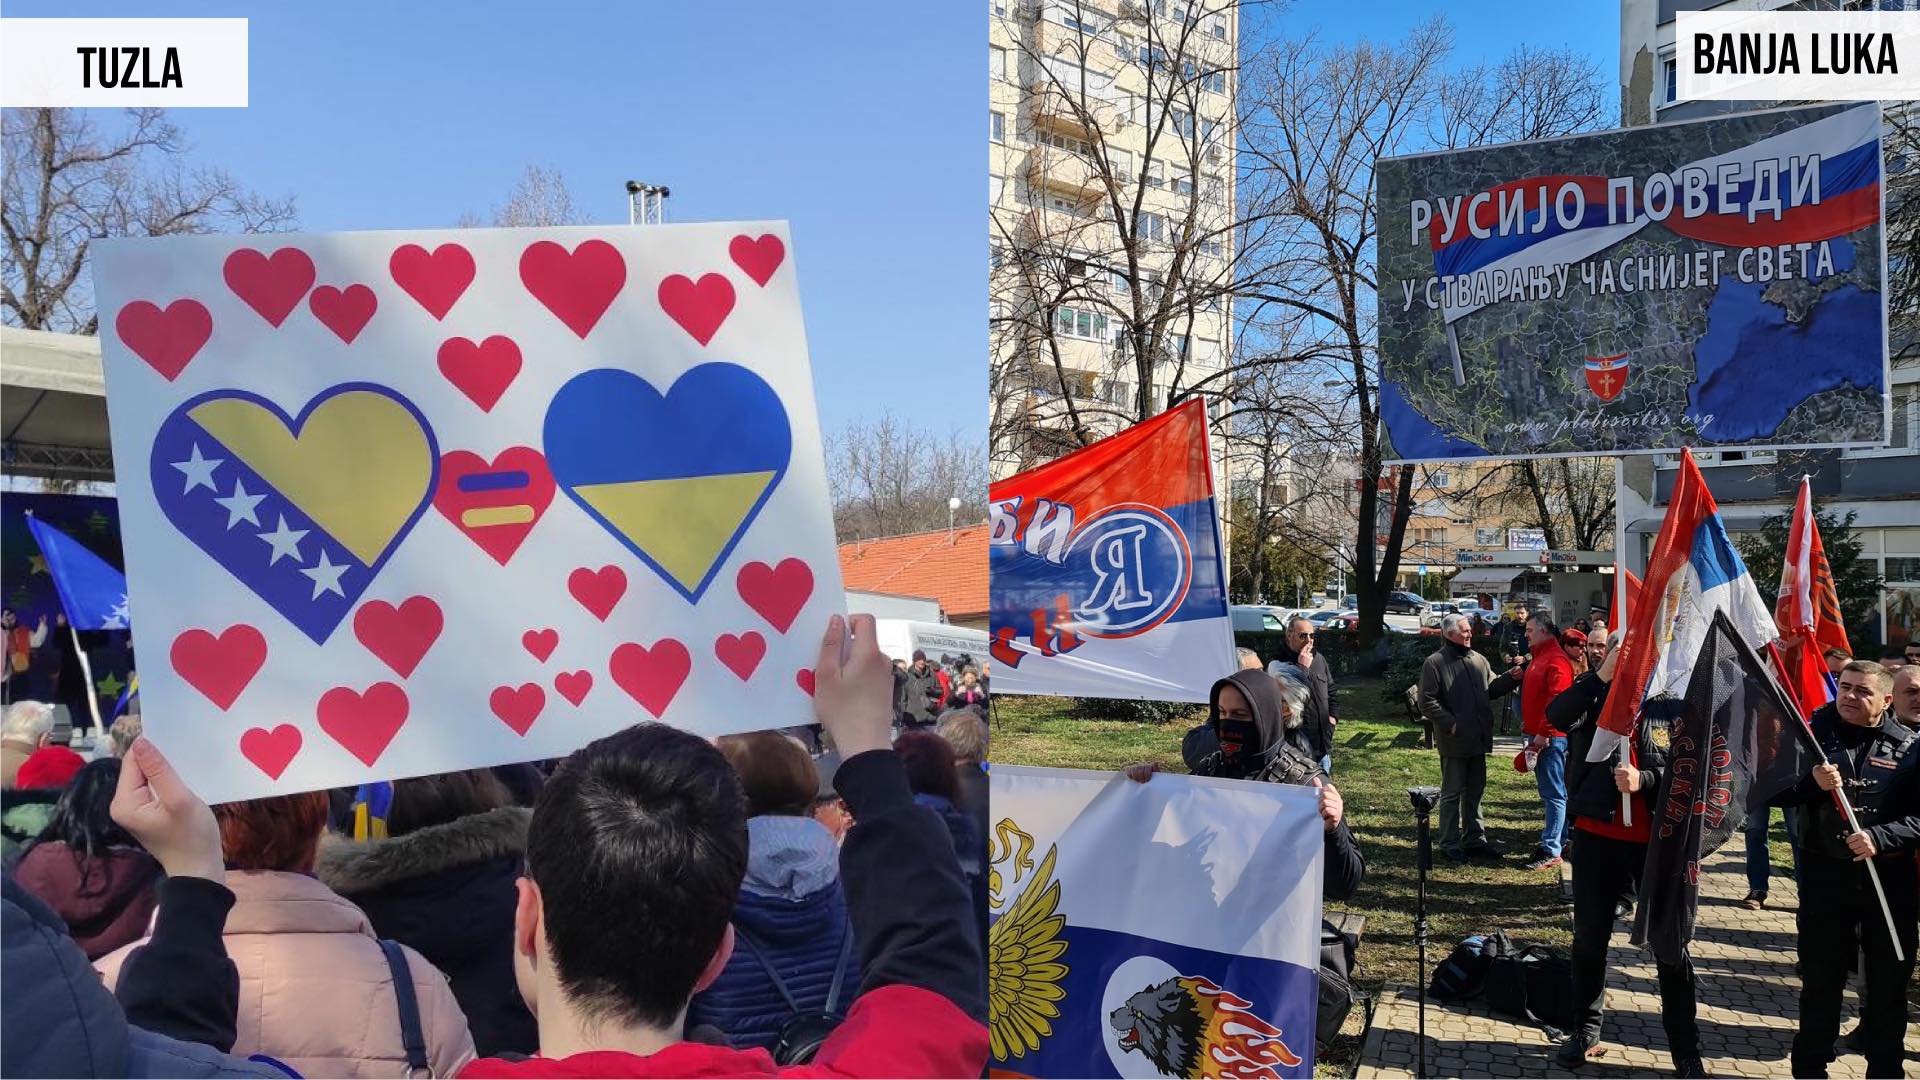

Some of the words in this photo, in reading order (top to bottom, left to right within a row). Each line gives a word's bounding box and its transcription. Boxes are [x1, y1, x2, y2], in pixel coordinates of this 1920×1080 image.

[1410, 174, 1586, 246] РУСИЈО
[1607, 153, 1822, 225] ПОВЕДИ
[1401, 277, 1415, 312] У
[1424, 263, 1571, 310] СТВАРАЊУ
[1580, 249, 1726, 296] ЧАСНИЈЕГ
[1736, 241, 1836, 283] СВЕТА
